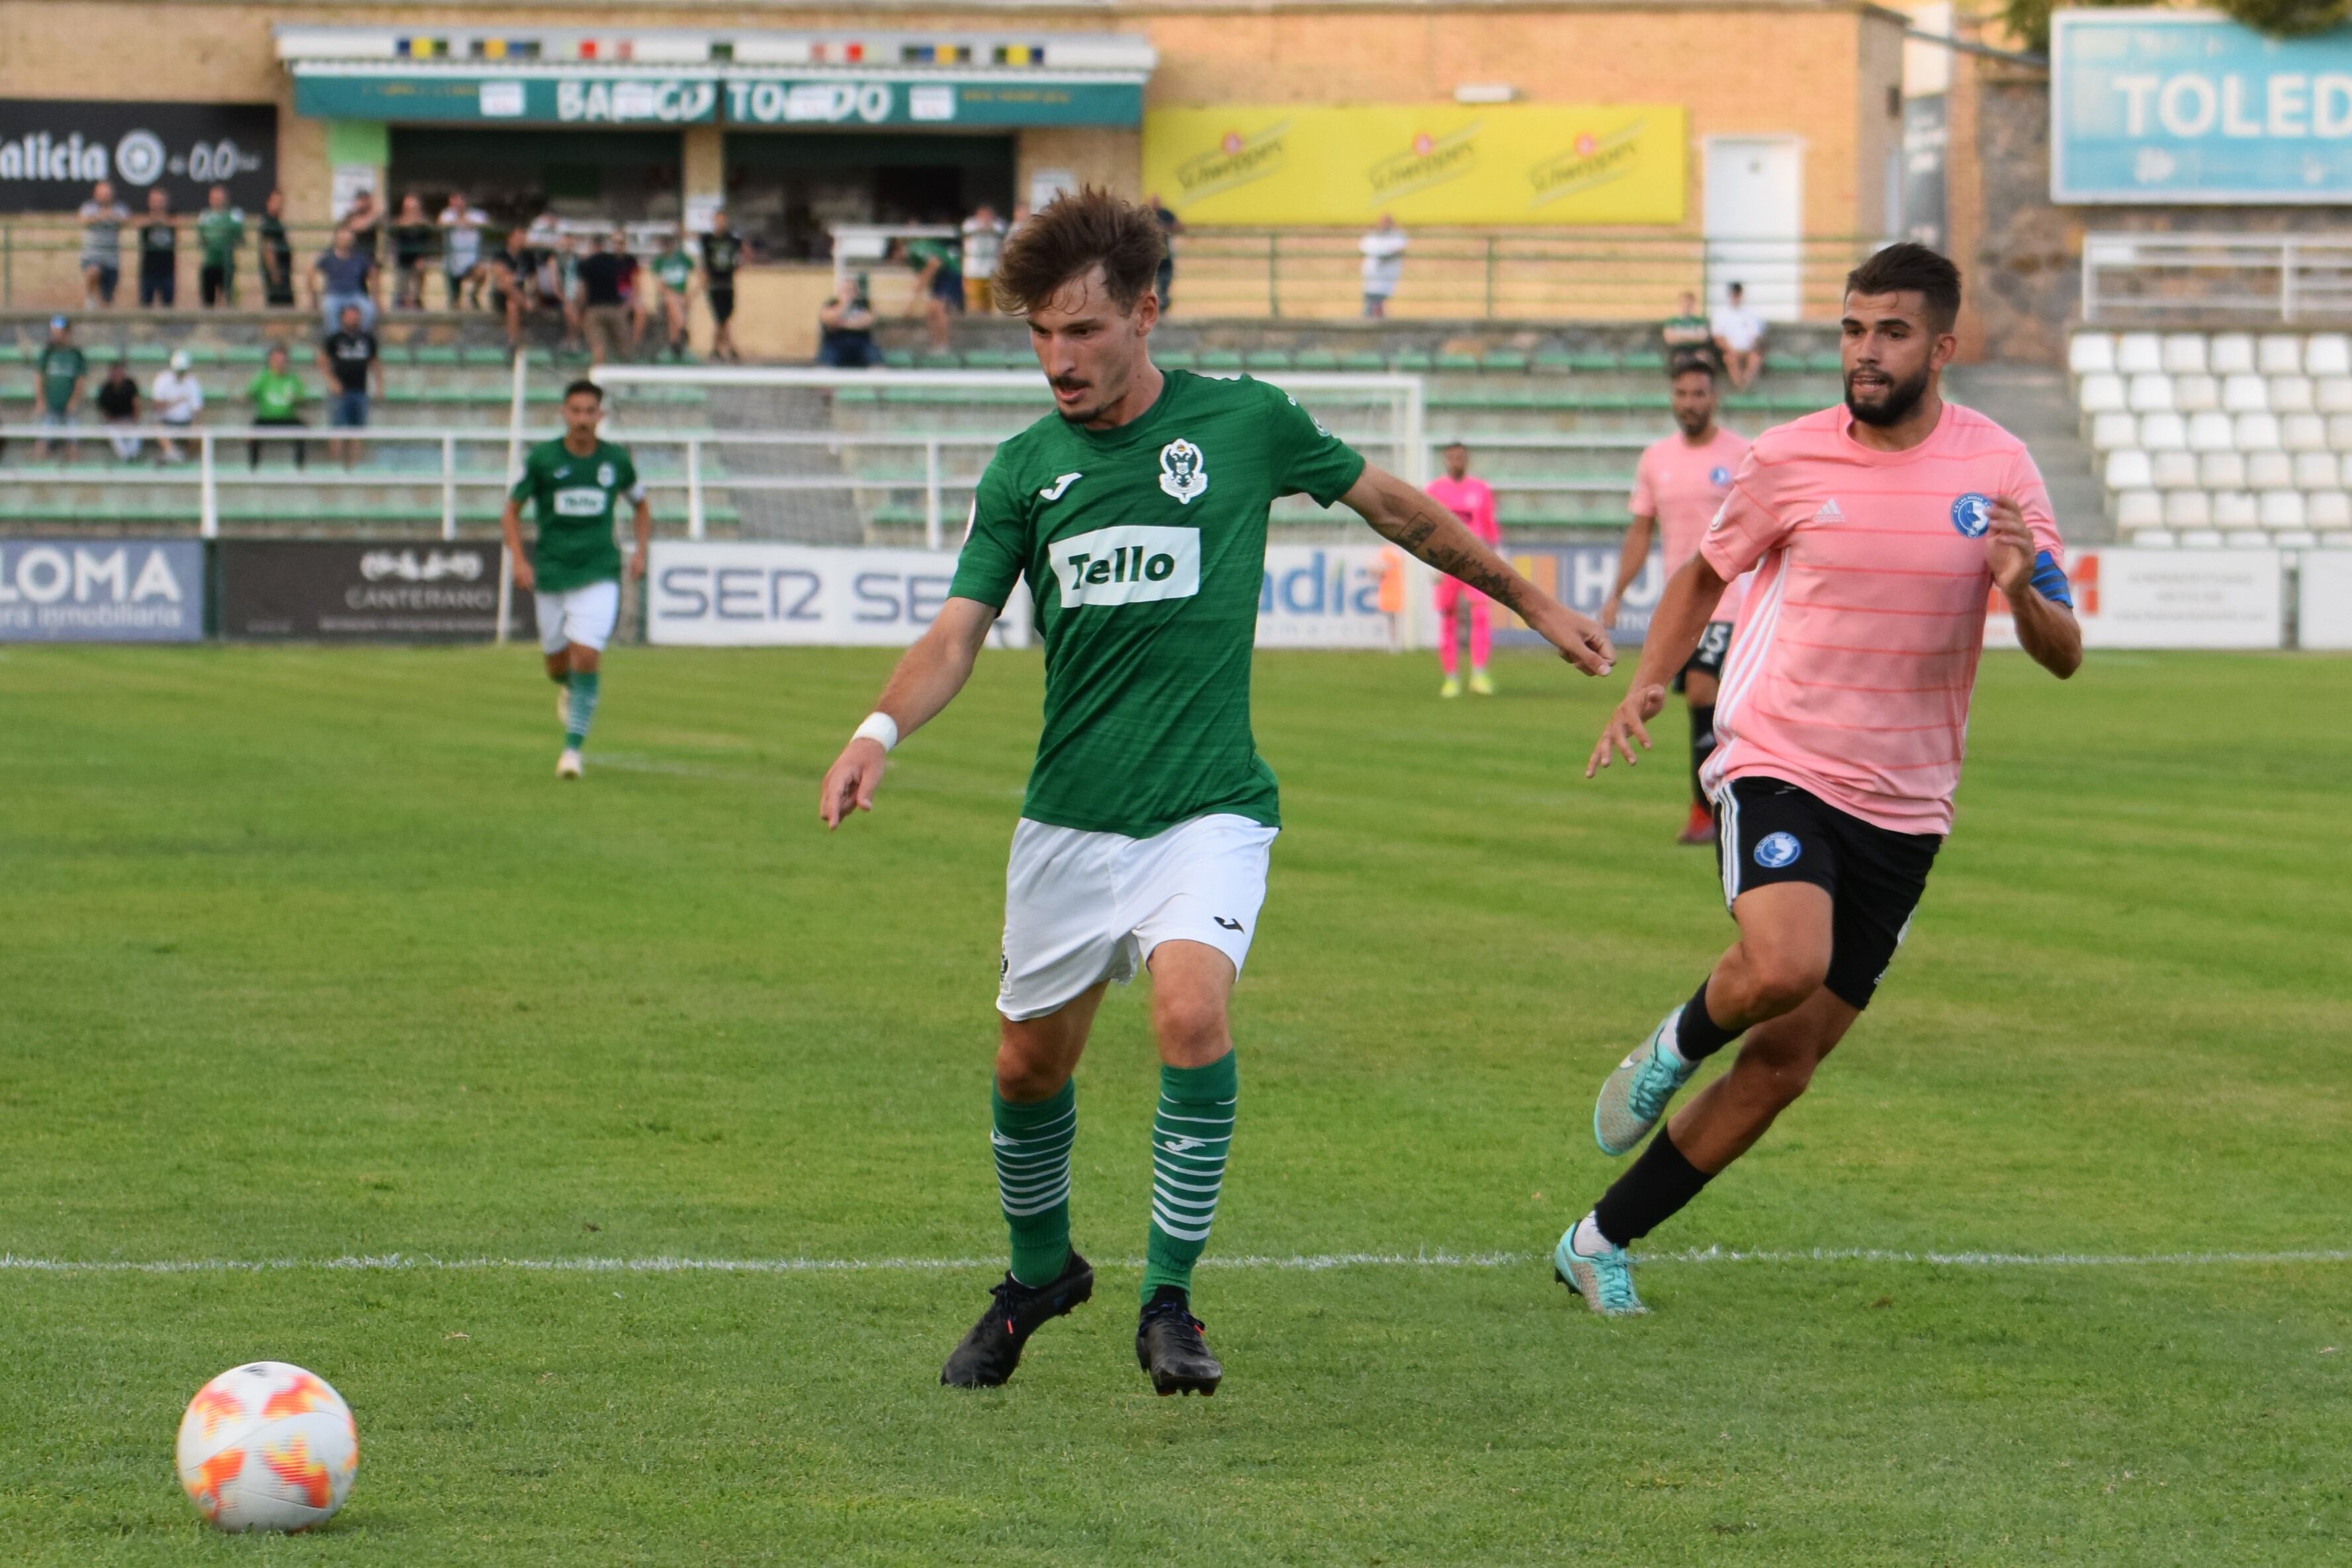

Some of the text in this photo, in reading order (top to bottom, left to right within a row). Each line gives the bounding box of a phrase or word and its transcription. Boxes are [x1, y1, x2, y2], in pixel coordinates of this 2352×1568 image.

[556, 81, 624, 122] BA
[728, 81, 894, 123] TODO
[2112, 73, 2352, 138] TOLED
[0, 130, 109, 181] alicia
[1067, 544, 1175, 590] Tello
[660, 566, 1013, 629] SER SE
